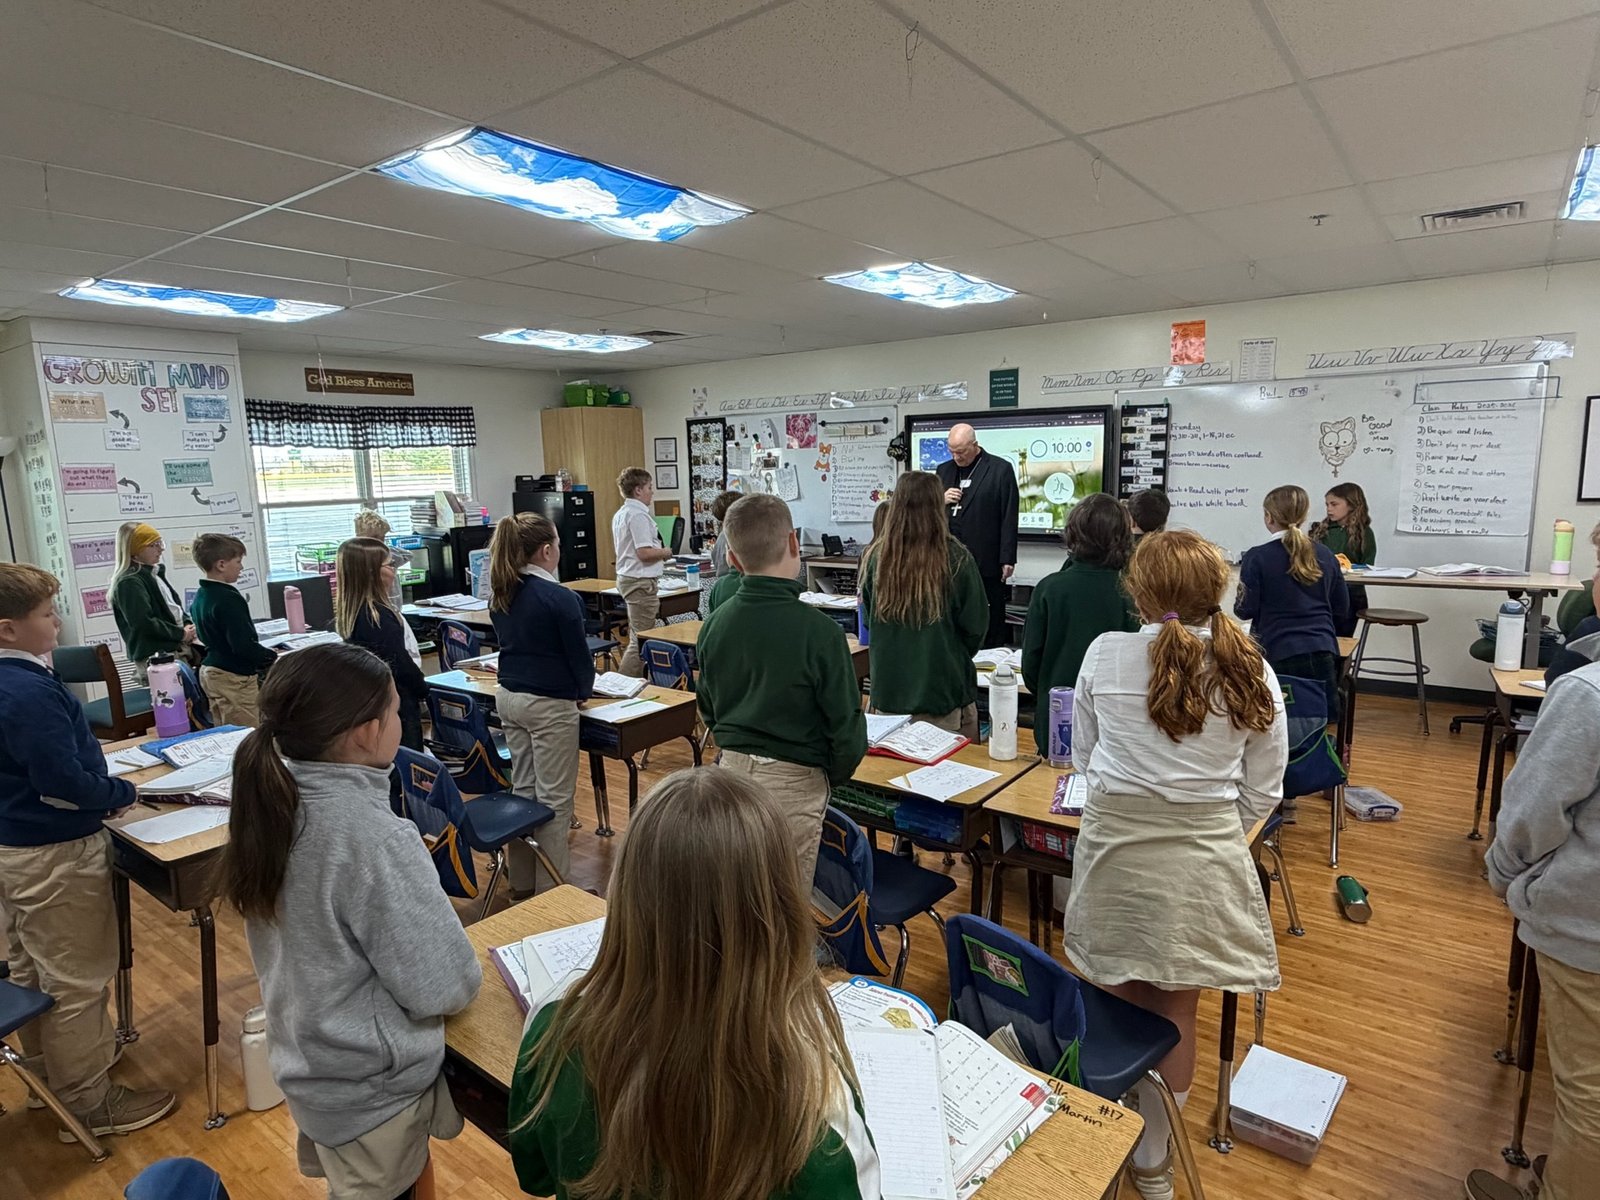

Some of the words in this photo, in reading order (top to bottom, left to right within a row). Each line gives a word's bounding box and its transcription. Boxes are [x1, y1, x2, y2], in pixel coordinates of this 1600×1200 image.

[1309, 354, 1349, 370] Uu
[1355, 351, 1383, 366] Vv
[1385, 346, 1434, 364] Ww
[1435, 343, 1474, 360] Xx
[1480, 340, 1525, 364] Yy
[43, 358, 156, 387] GROWTH
[168, 363, 229, 390] MIND
[307, 373, 333, 386] God
[335, 375, 365, 387] Bless
[367, 377, 412, 390] America
[1105, 370, 1128, 385] Oo
[1131, 368, 1158, 388] Pp
[1196, 363, 1230, 378] Rr
[141, 386, 178, 413] SET
[1361, 413, 1376, 423] Be
[1368, 418, 1393, 430] Good
[1052, 441, 1082, 454] 10:00
[73, 541, 98, 549] There's
[1058, 1103, 1102, 1127] Martin
[1097, 1104, 1124, 1120] #17
